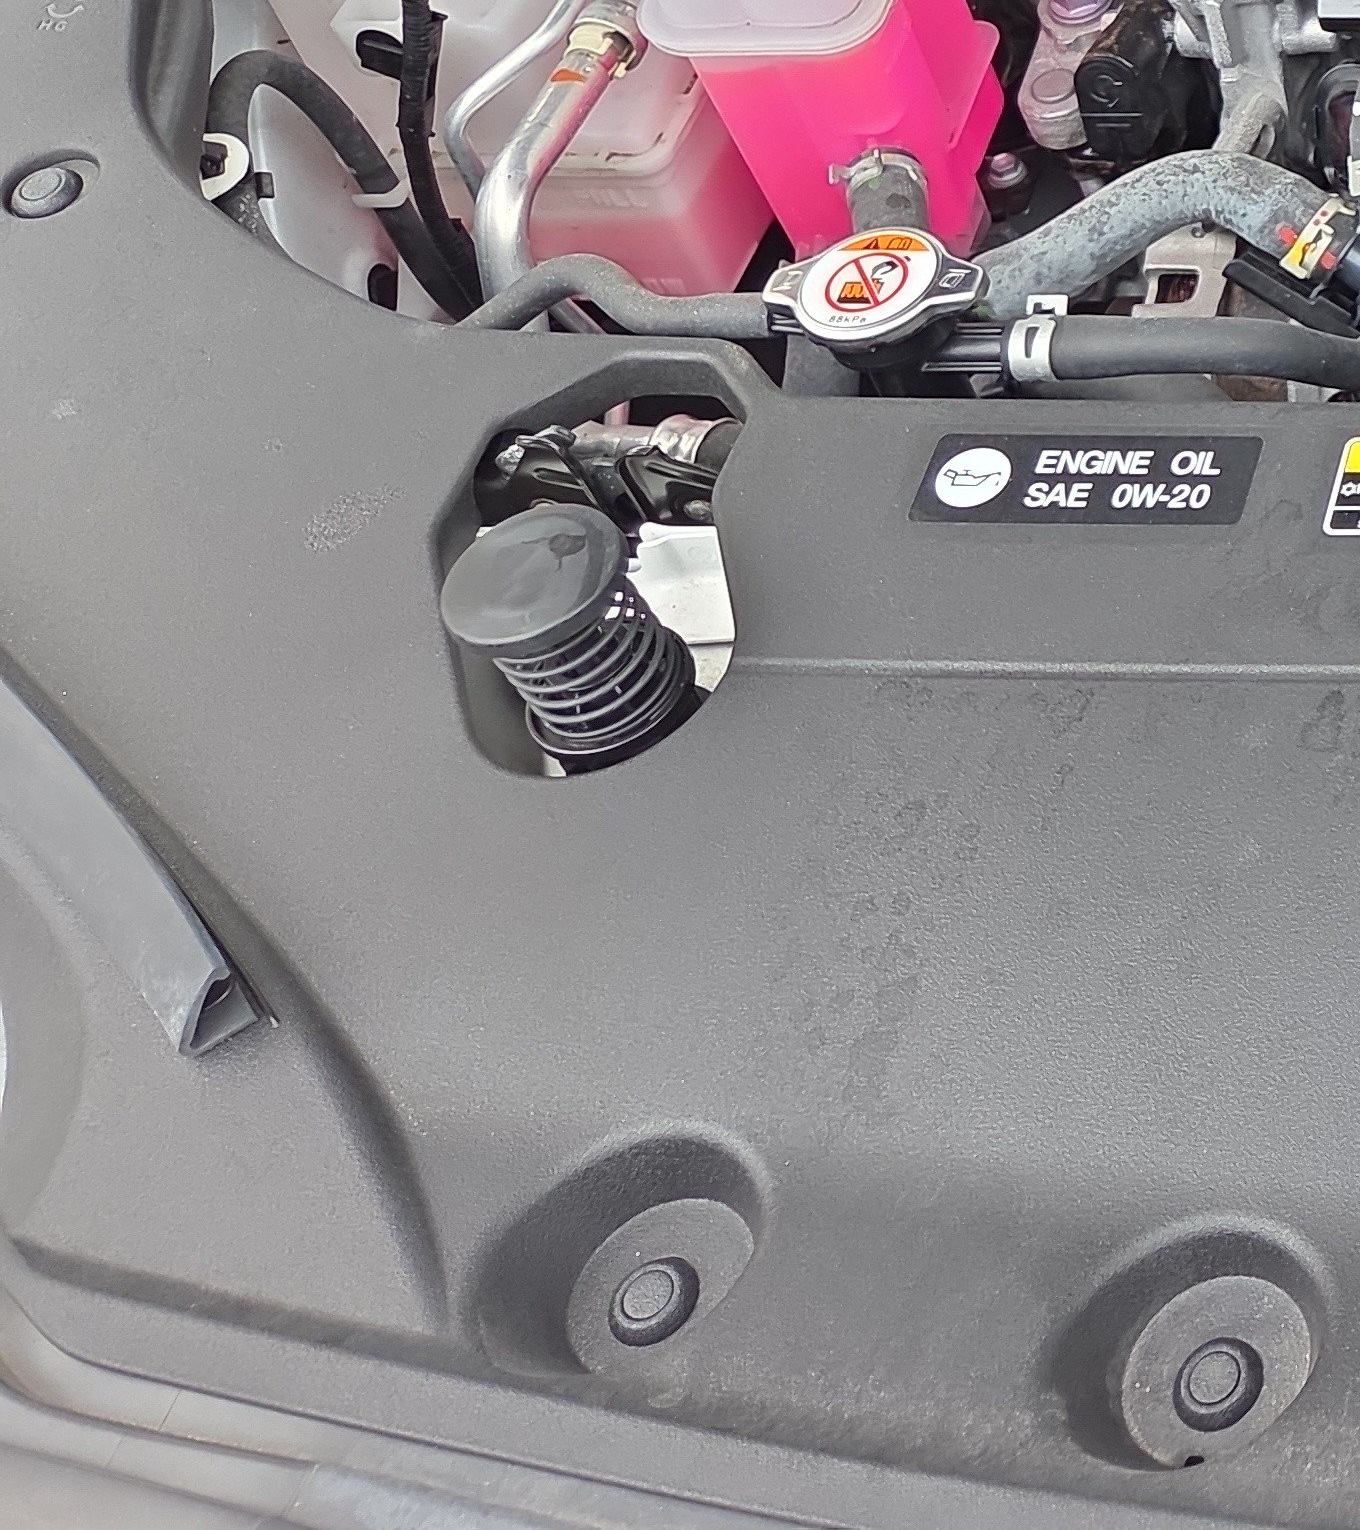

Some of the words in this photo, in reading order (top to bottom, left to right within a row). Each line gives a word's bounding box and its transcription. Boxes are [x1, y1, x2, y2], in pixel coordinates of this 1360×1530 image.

[828, 315, 868, 323] 88kPa
[1033, 450, 1155, 476] ENGINE
[1170, 451, 1222, 476] OIL
[1022, 483, 1094, 509] SAE
[1110, 483, 1213, 509] 0W-20
